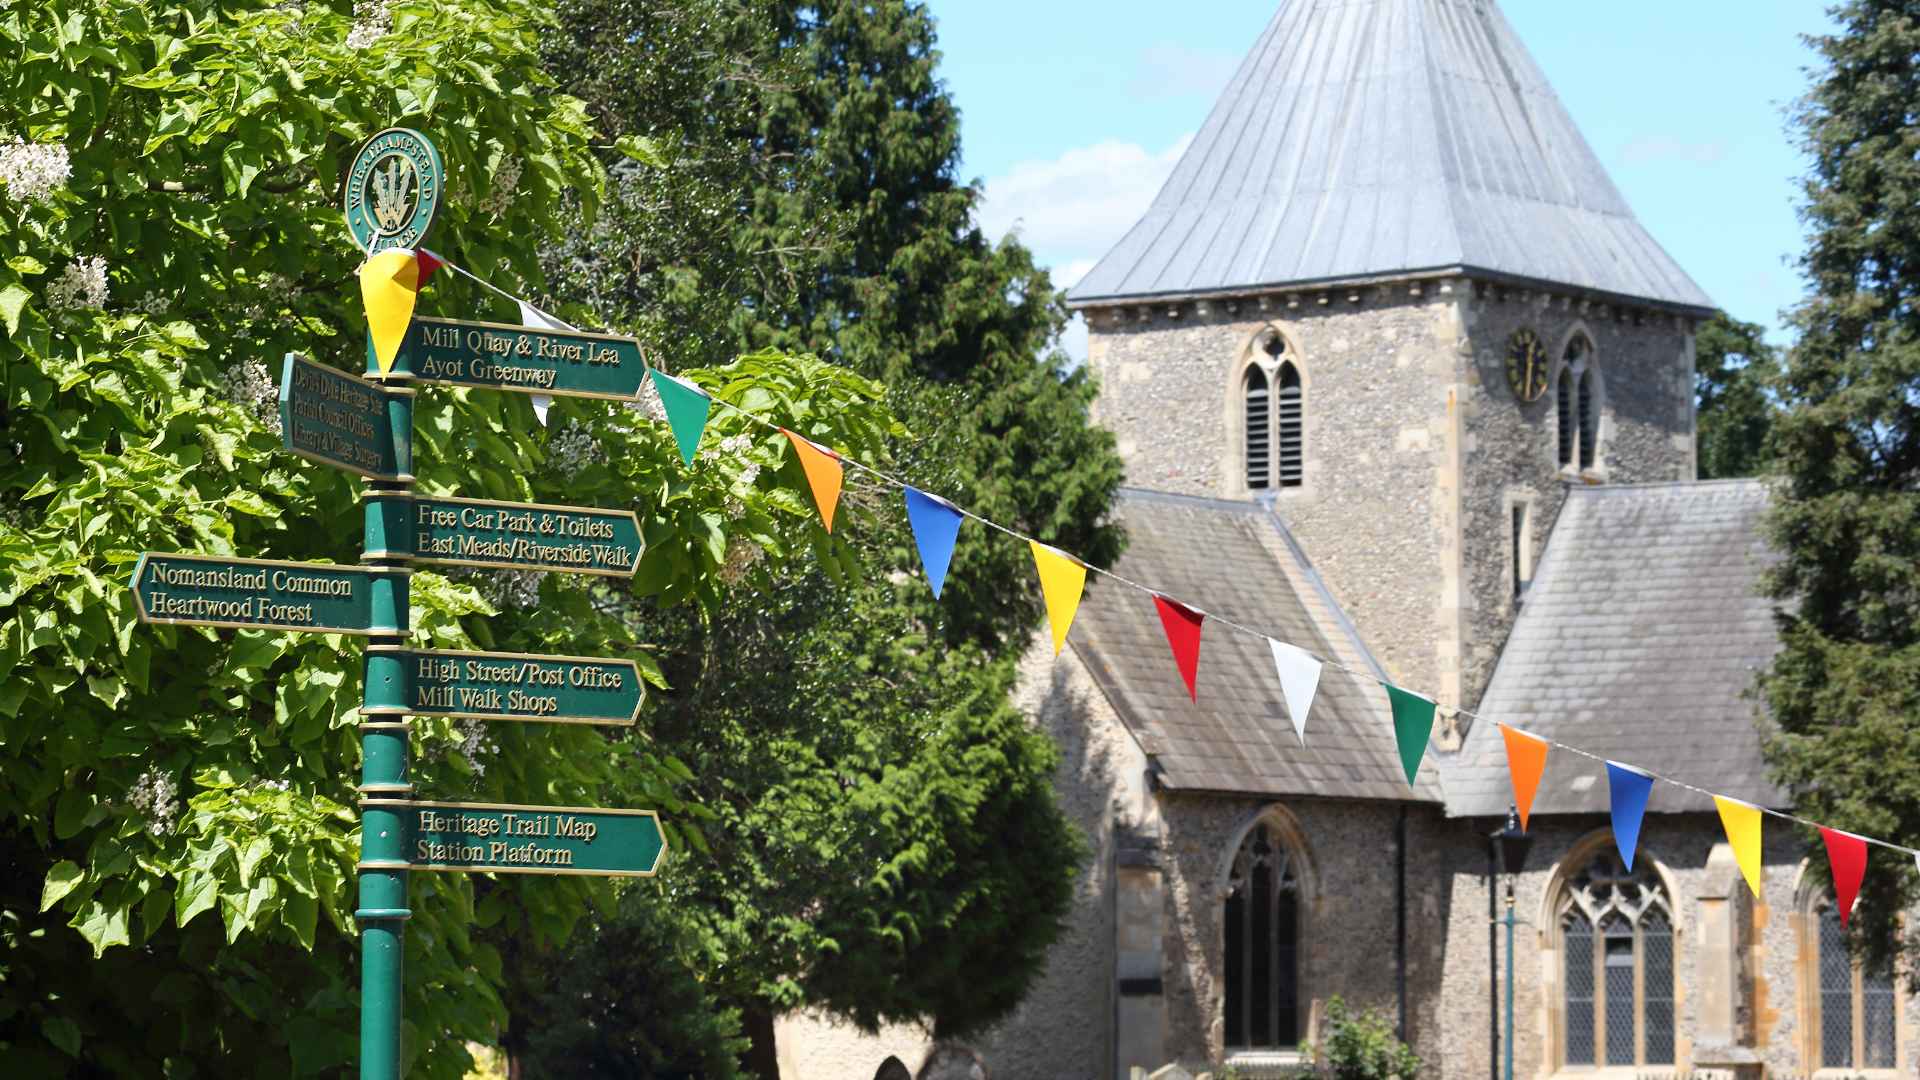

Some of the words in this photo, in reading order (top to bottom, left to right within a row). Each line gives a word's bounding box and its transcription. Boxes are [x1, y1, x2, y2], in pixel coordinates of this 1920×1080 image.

[351, 136, 432, 209] WHEATHAMPSTEAD
[366, 226, 418, 248] VLLAGE
[423, 327, 459, 349] Mill
[467, 330, 512, 358] Quay
[515, 334, 532, 355] &
[536, 337, 583, 360] River
[587, 342, 621, 364] Lea
[421, 354, 464, 378] Ayot
[470, 358, 556, 388] Greenway
[294, 391, 320, 420] Parish
[319, 402, 348, 428] Council
[320, 375, 339, 402] Dyke
[340, 381, 369, 413] Heritage
[418, 504, 456, 527] Free
[461, 508, 492, 529] Car
[496, 510, 536, 533] Park
[539, 513, 556, 535] &
[556, 515, 613, 538] Toilets
[418, 532, 454, 554] East
[457, 535, 591, 563] Meads/Riverside
[591, 544, 632, 567] Walk
[150, 562, 267, 590] Nomansland
[273, 570, 352, 596] Common
[150, 592, 252, 617] Heartwood
[256, 598, 312, 622] Forest
[418, 657, 460, 682] High
[466, 660, 564, 685] Street/Post
[569, 666, 622, 688] Office
[417, 686, 455, 707] Mill
[458, 687, 501, 709] Walk
[508, 690, 558, 715] Shops
[418, 811, 500, 837] Heritage
[503, 814, 550, 836] Trail
[554, 816, 597, 841] Map
[417, 839, 484, 862] Station
[489, 841, 573, 865] Platform
